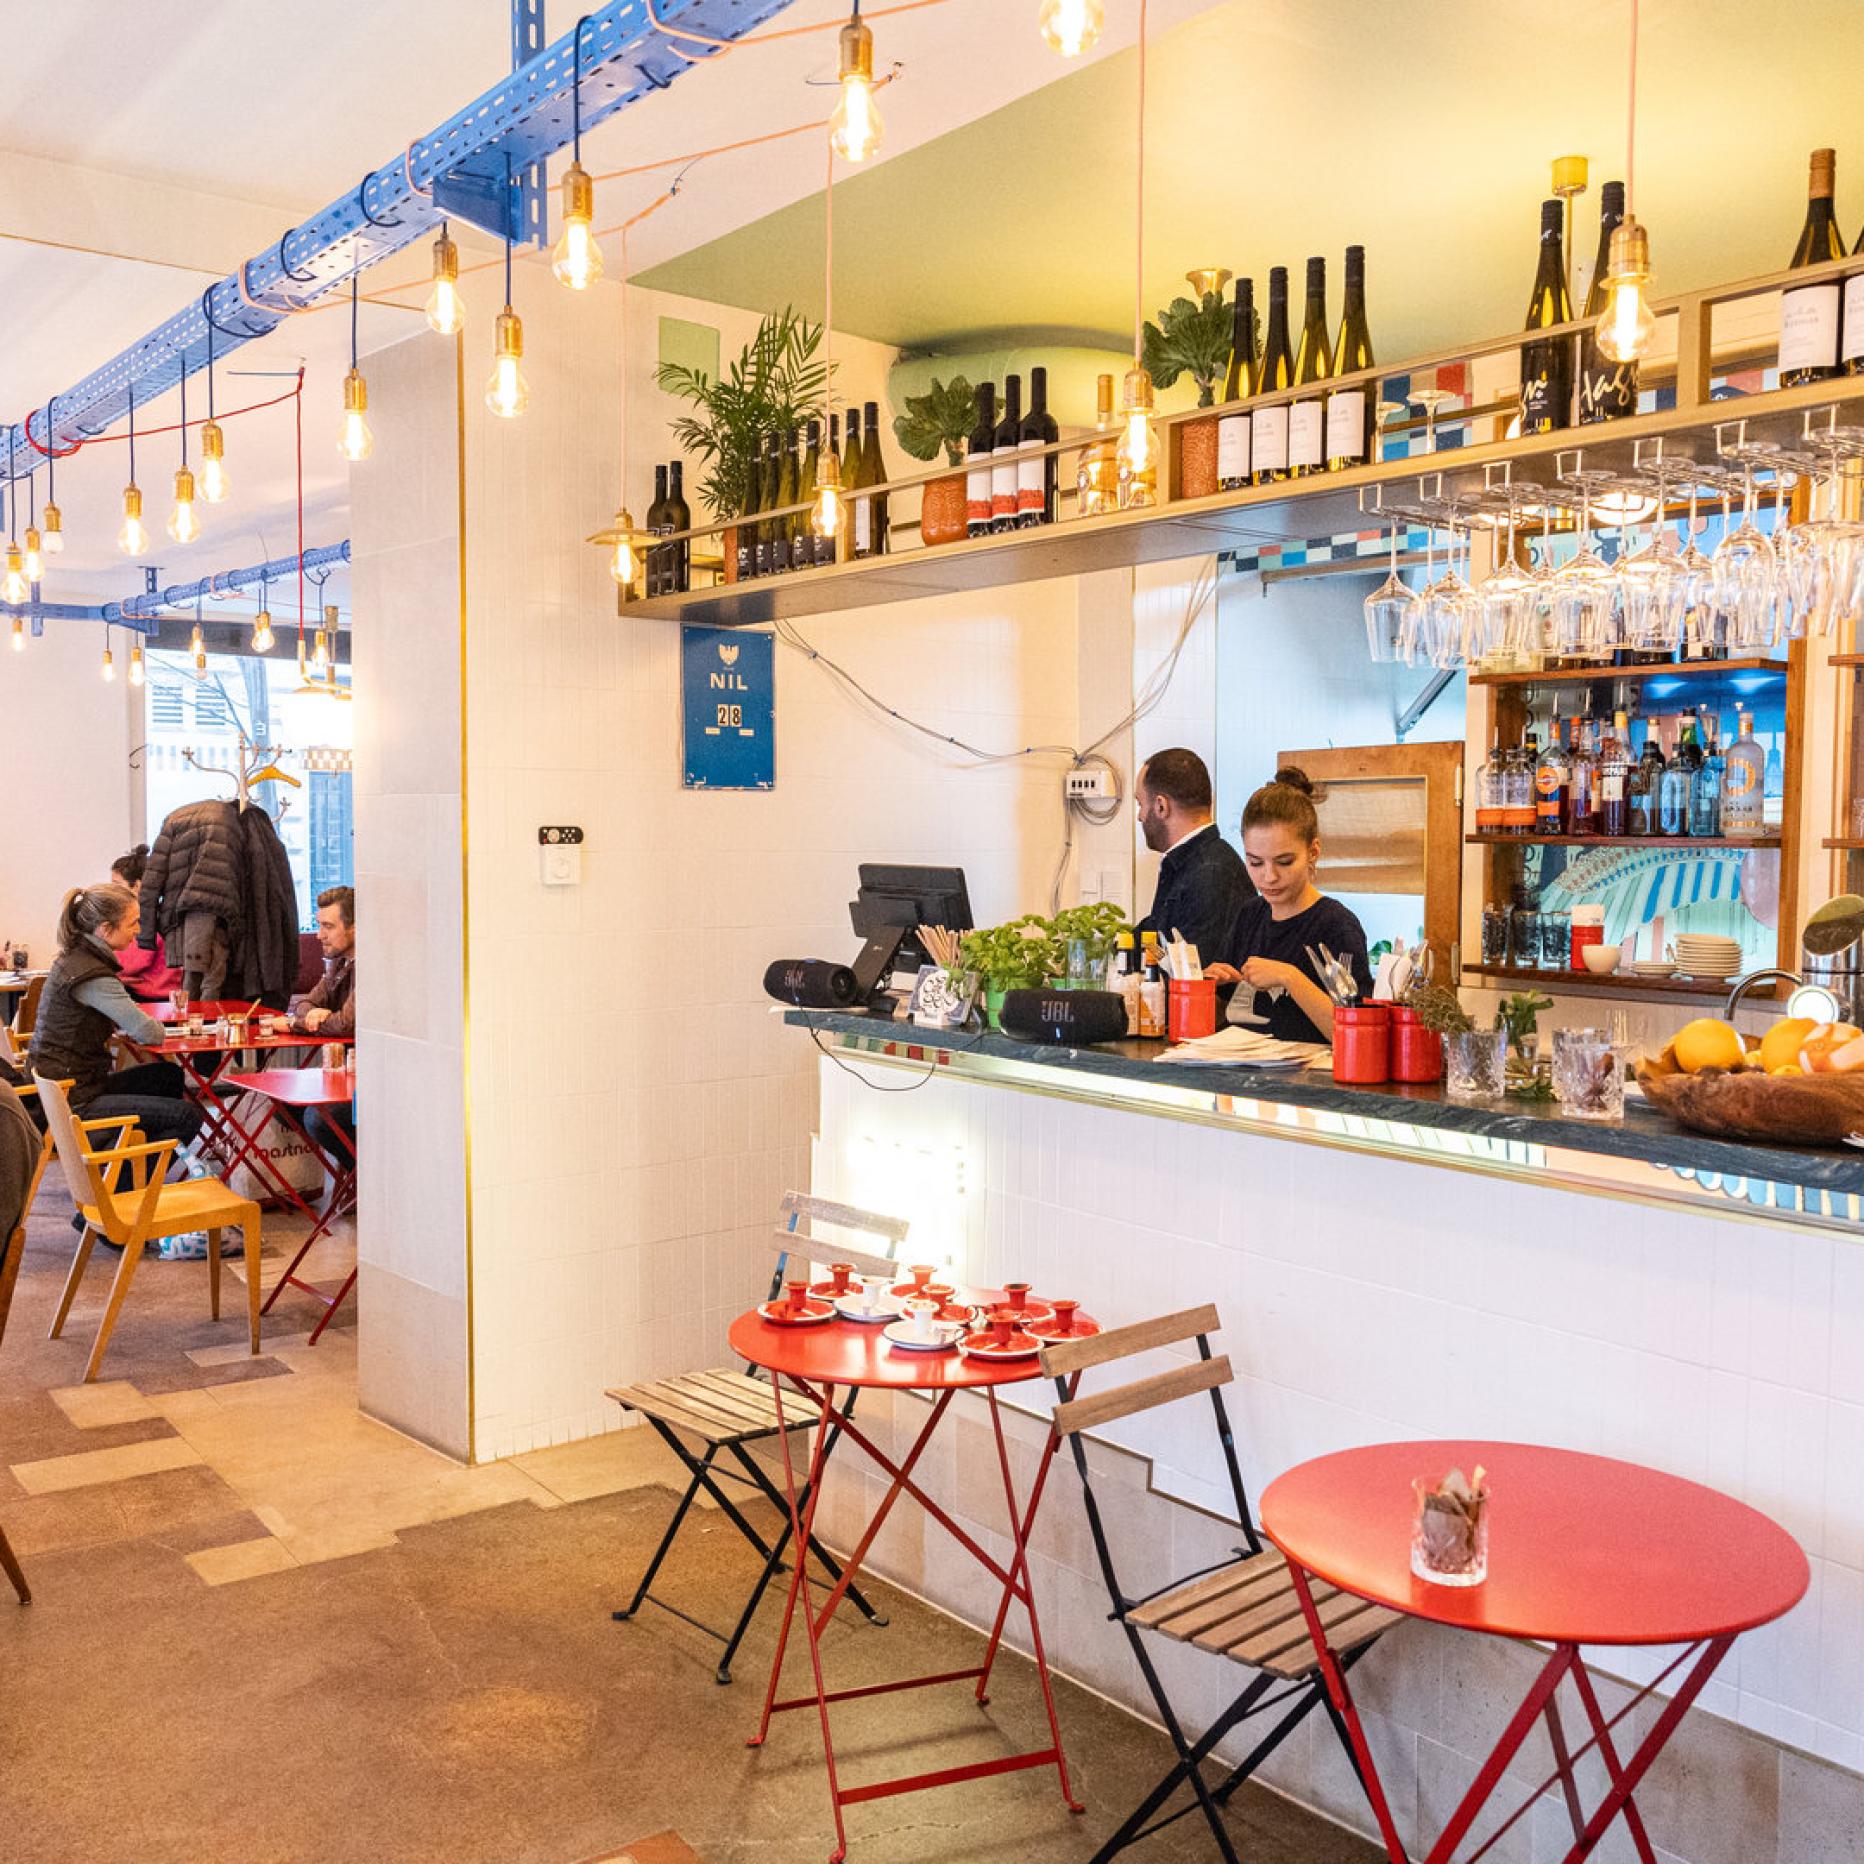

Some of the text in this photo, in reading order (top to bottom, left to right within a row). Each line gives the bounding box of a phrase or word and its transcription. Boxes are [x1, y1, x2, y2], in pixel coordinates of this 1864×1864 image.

[709, 672, 749, 691] NIL
[718, 706, 742, 725] 28
[1041, 1000, 1075, 1023] JBL
